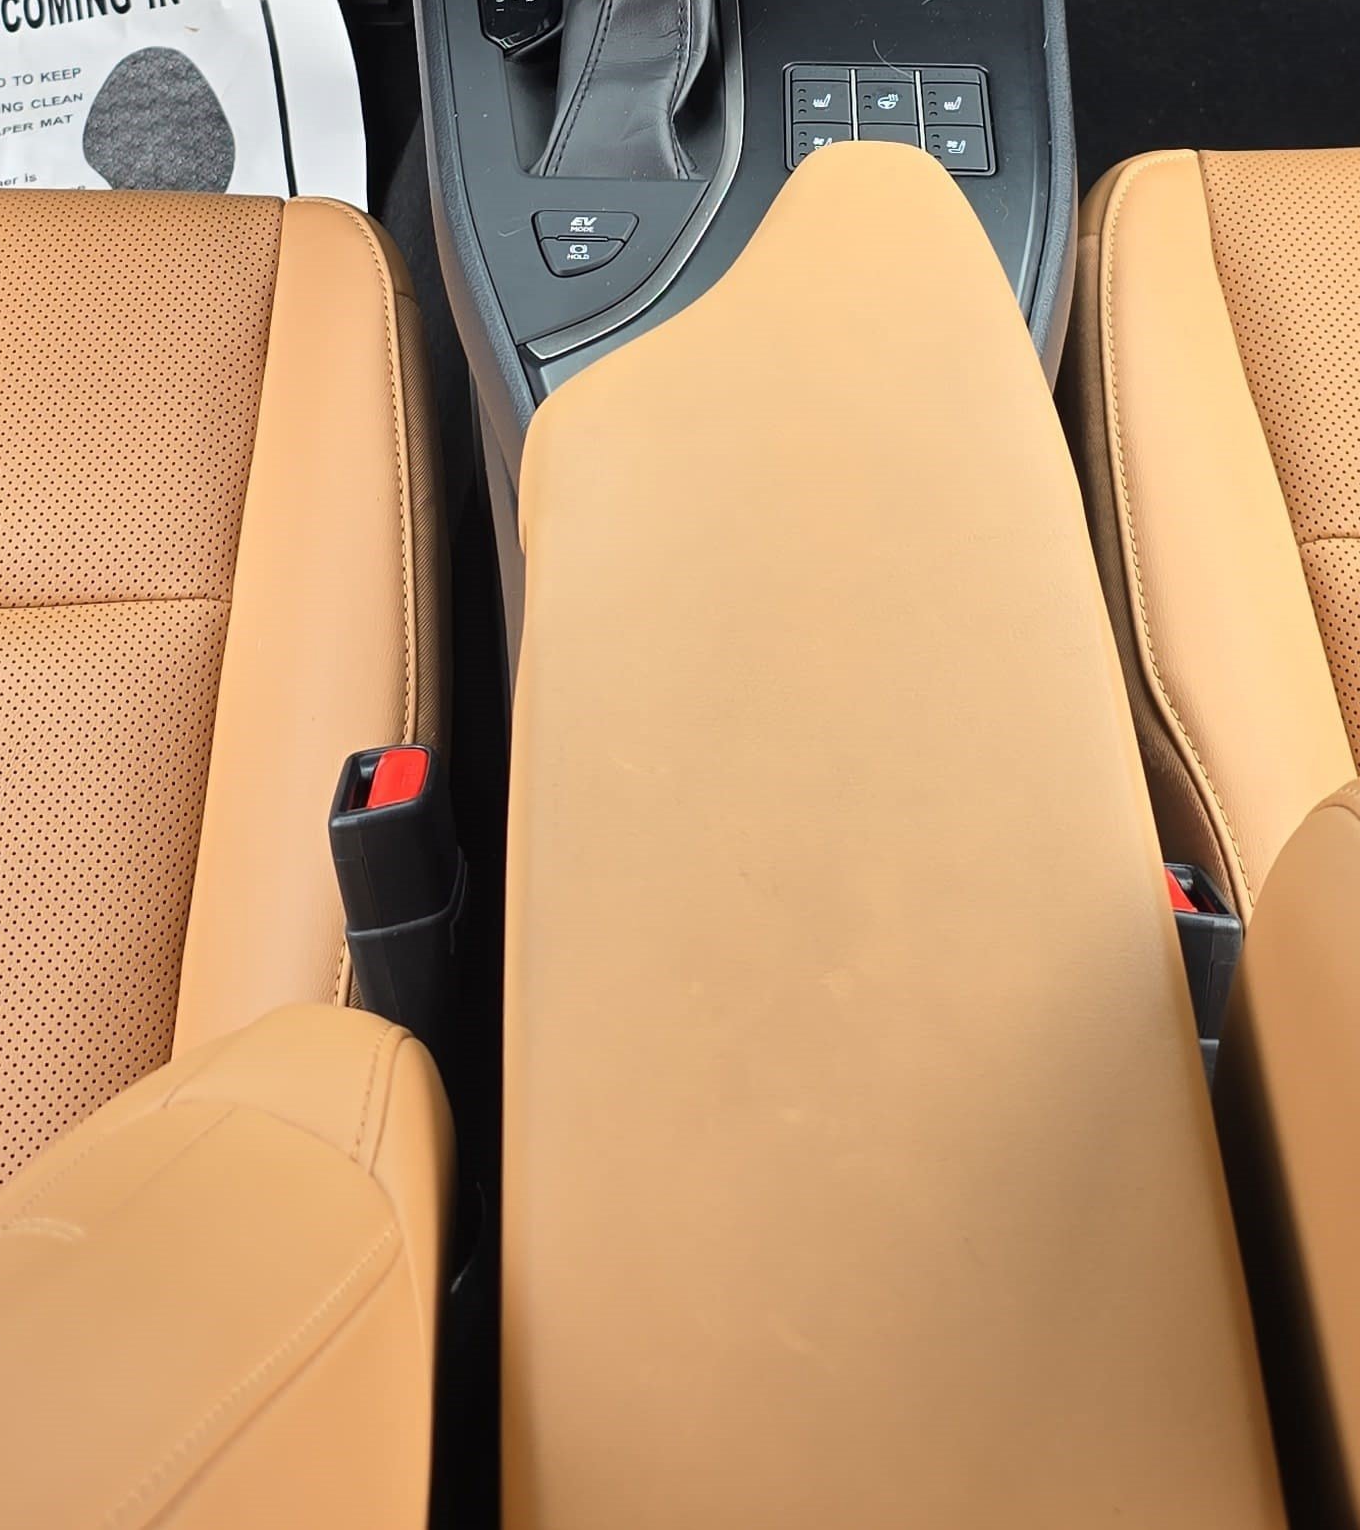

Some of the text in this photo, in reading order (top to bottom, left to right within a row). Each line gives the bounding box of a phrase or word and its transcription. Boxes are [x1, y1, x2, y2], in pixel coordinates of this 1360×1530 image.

[13, 73, 34, 87] TO
[40, 67, 82, 83] KEEP
[31, 92, 84, 109] CLEAN
[40, 114, 75, 129] MAT
[24, 172, 38, 183] is
[570, 216, 598, 226] EV
[569, 225, 595, 233] MODE
